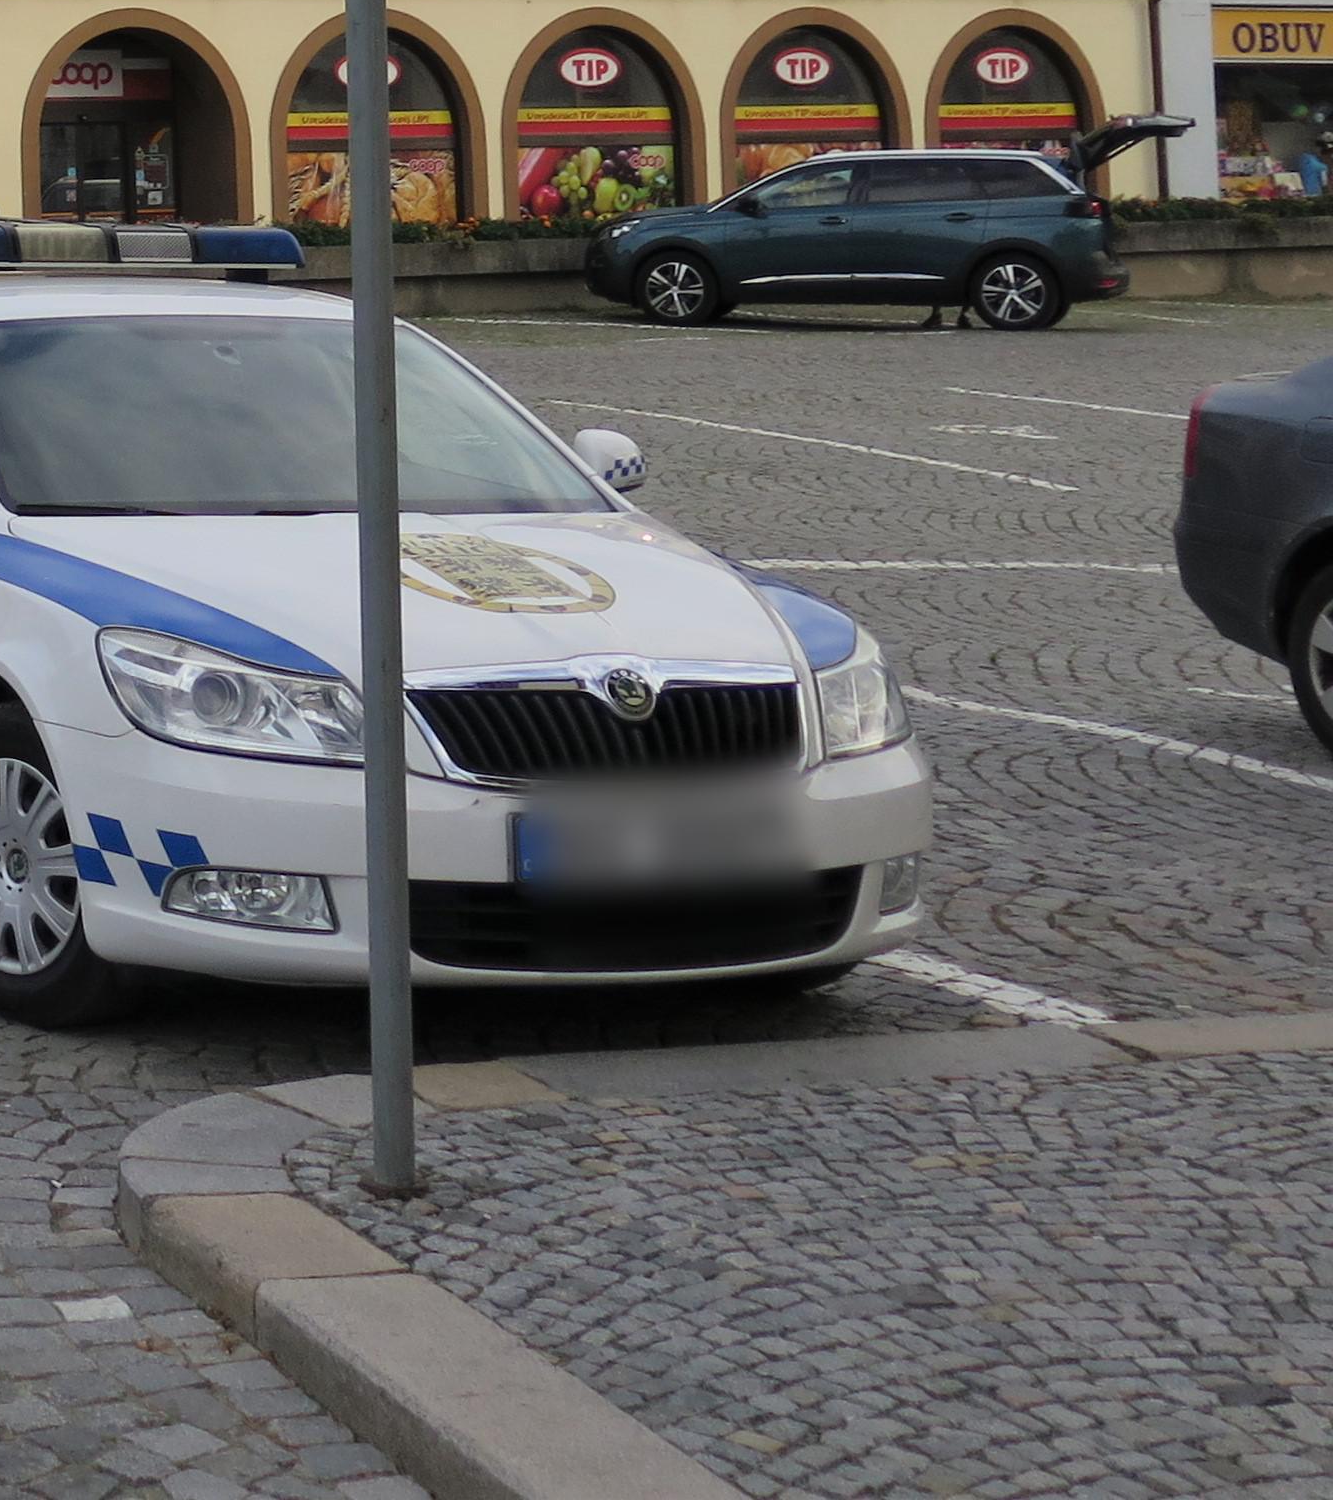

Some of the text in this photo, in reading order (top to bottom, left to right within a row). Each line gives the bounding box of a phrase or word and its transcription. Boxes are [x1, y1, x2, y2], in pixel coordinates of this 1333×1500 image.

[1233, 22, 1326, 53] OBUV
[52, 62, 113, 90] oop
[572, 59, 609, 82] TIP
[786, 58, 821, 80] TIP
[988, 58, 1020, 79] TIP
